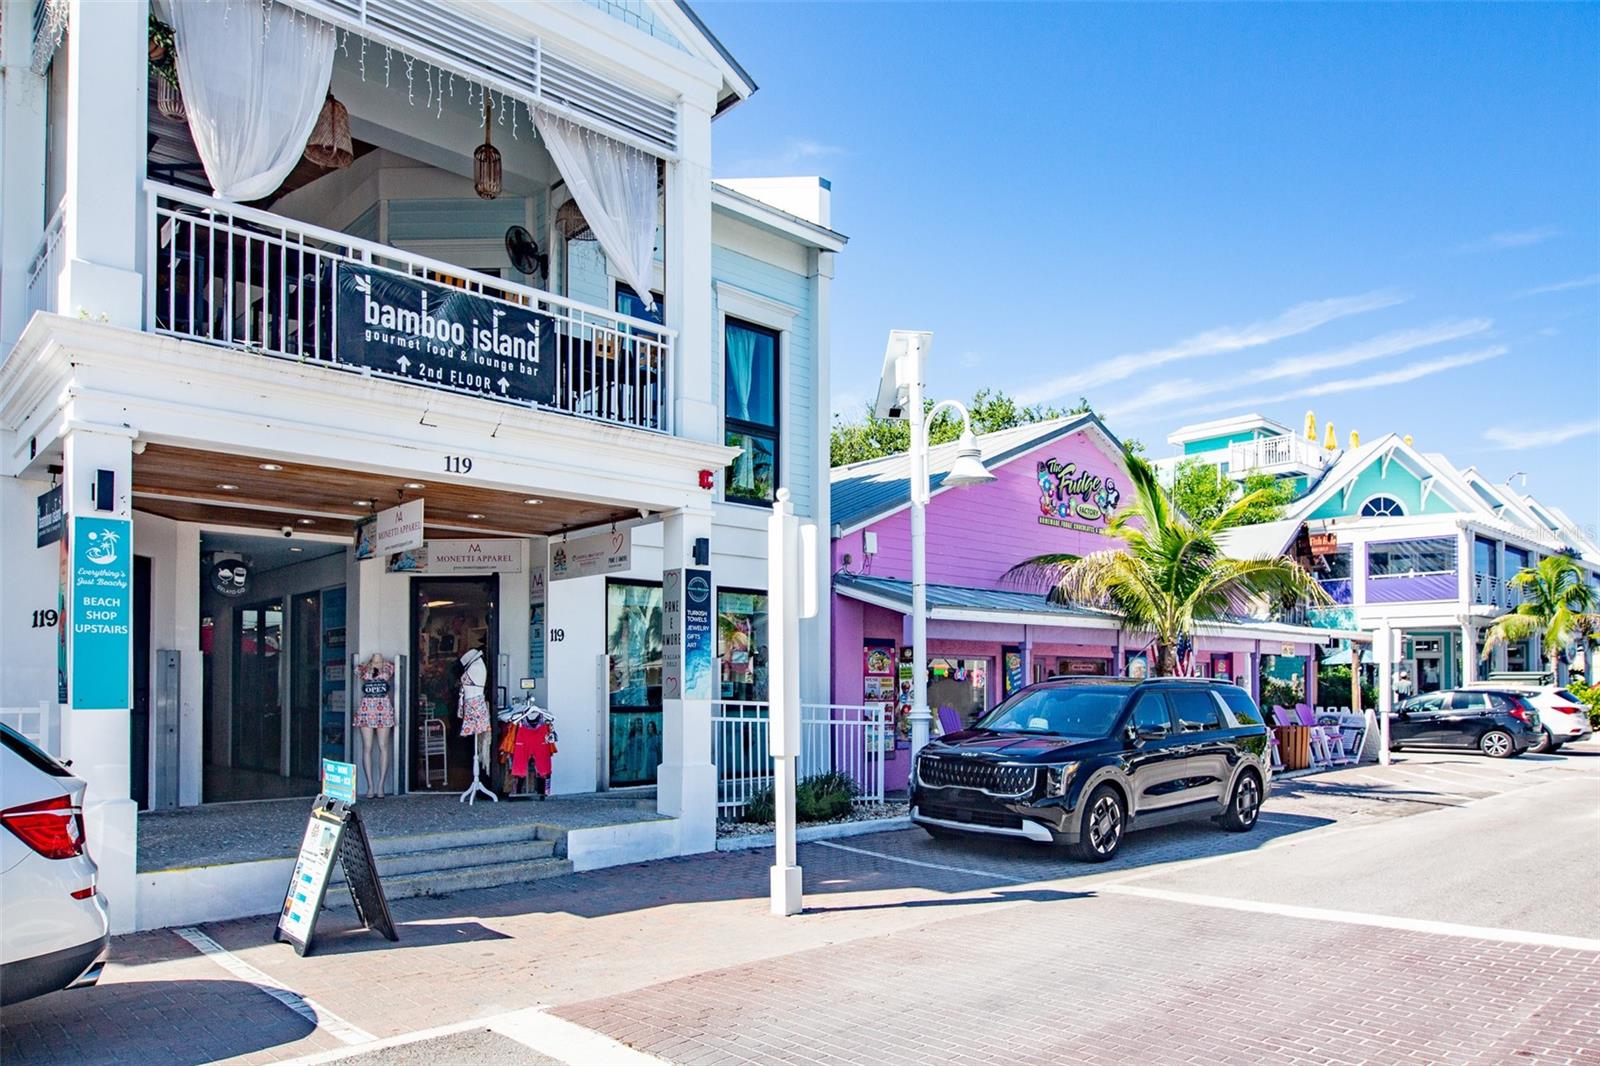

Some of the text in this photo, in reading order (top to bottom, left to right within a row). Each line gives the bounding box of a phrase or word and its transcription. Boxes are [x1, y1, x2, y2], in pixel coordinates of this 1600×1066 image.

[358, 276, 540, 363] bamboo island
[365, 329, 538, 376] gourmet food & lounge bar
[419, 363, 491, 389] 2nd FLOOR
[443, 455, 473, 474] 119
[1046, 458, 1063, 474] The
[1057, 463, 1101, 502] Fudge
[1079, 506, 1099, 516] FACTORY
[436, 554, 513, 562] MONETTI APPAREL
[77, 567, 126, 579] Everything's
[76, 577, 128, 589] Just Beachy
[83, 597, 120, 607] BEACH
[664, 601, 679, 613] PANE
[32, 609, 58, 628] 119
[86, 610, 117, 620] SHOP
[75, 624, 128, 634] UPSTAIRS
[669, 617, 674, 629] E
[550, 629, 565, 642] 119
